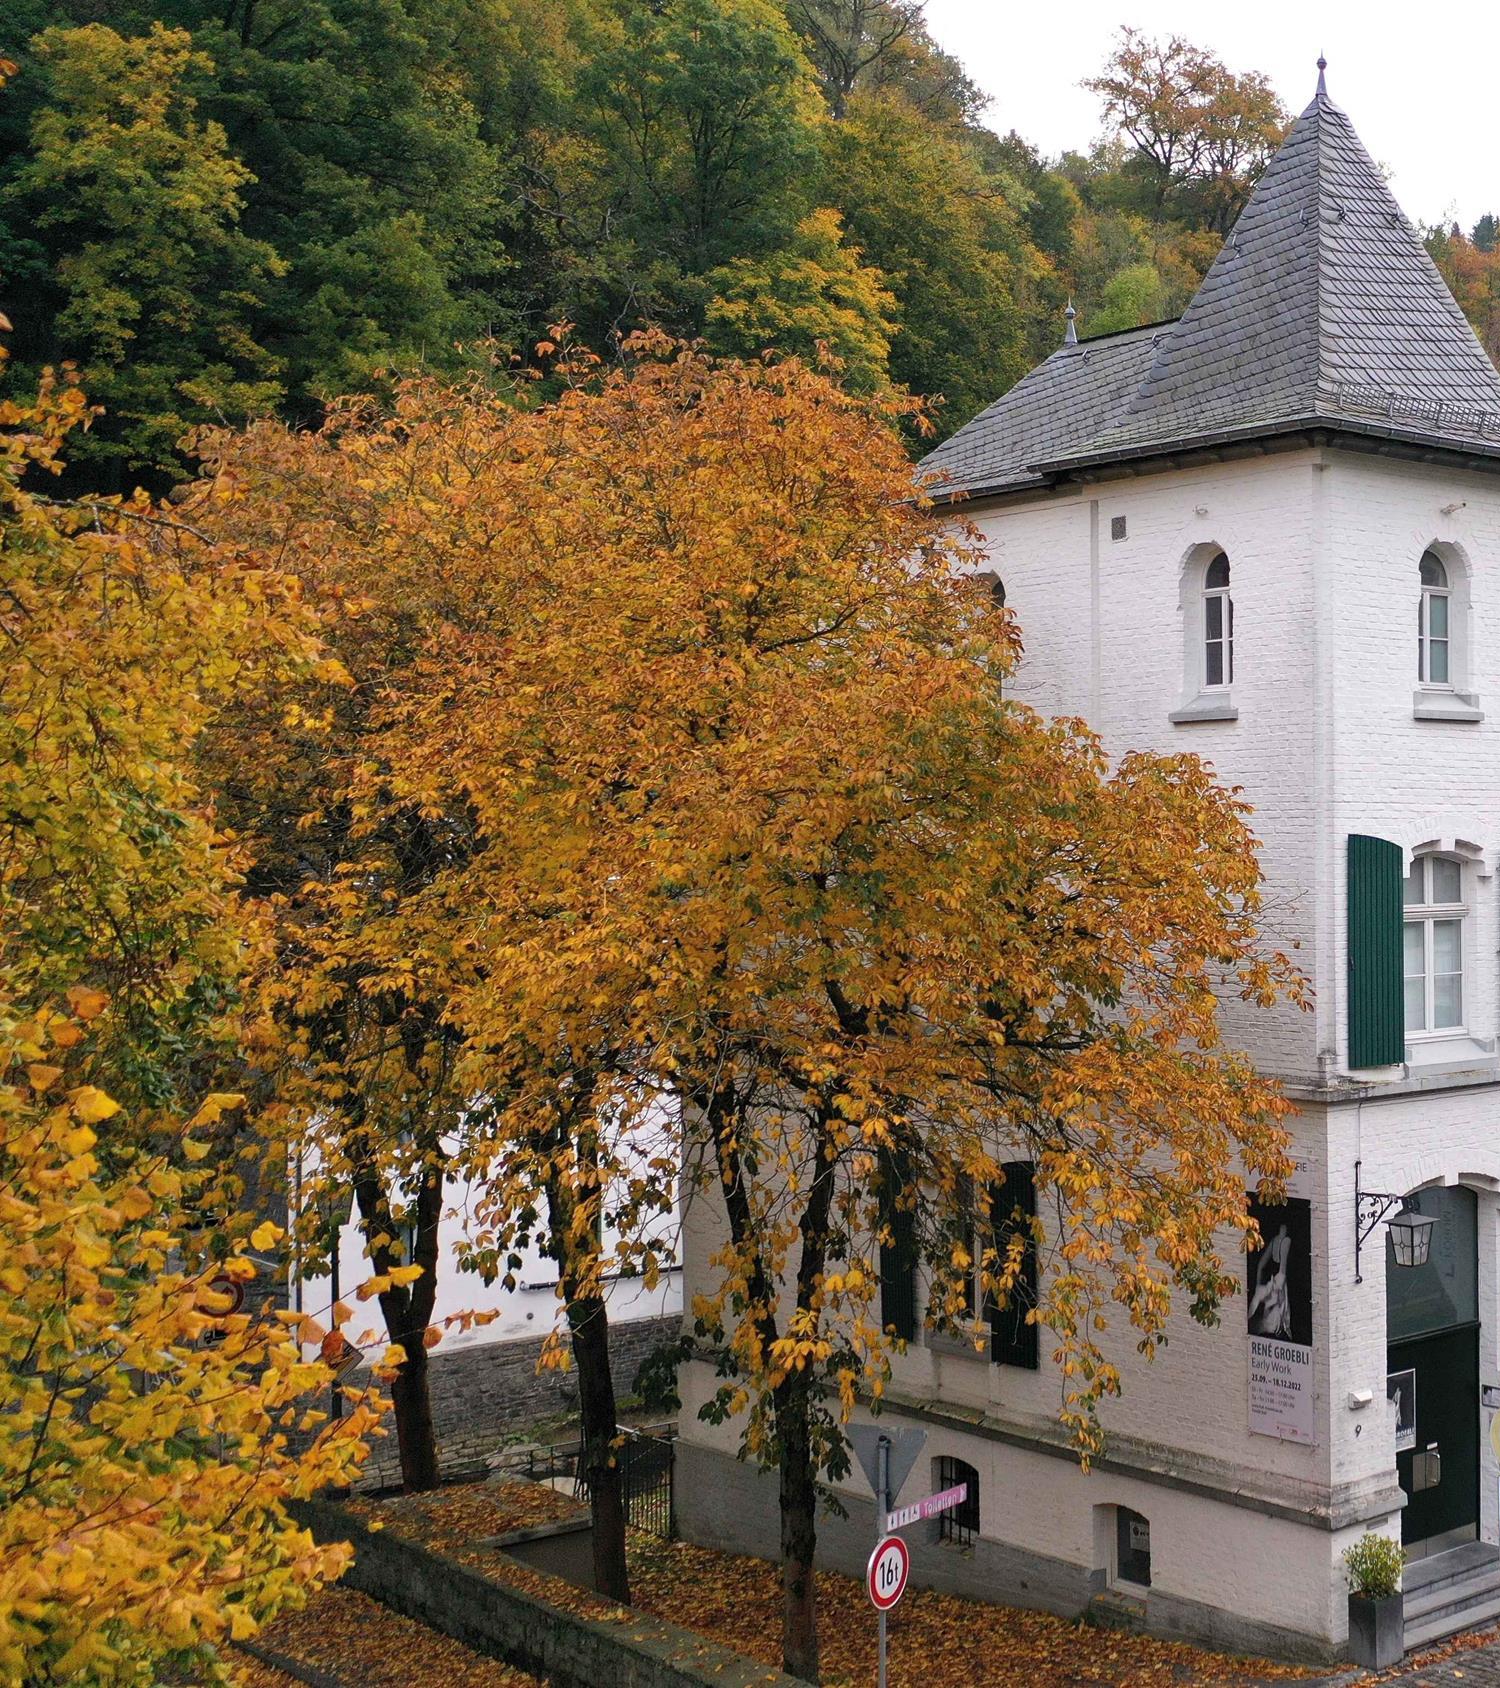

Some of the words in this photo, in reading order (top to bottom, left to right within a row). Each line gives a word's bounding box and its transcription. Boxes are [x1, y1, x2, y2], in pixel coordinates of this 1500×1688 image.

[1251, 1341, 1272, 1358] RENÉ
[1274, 1346, 1310, 1366] GROEBLI
[1251, 1358, 1270, 1374] Early
[1271, 1361, 1292, 1376] Work
[1355, 1424, 1362, 1438] 9
[923, 1494, 957, 1518] Toiletten
